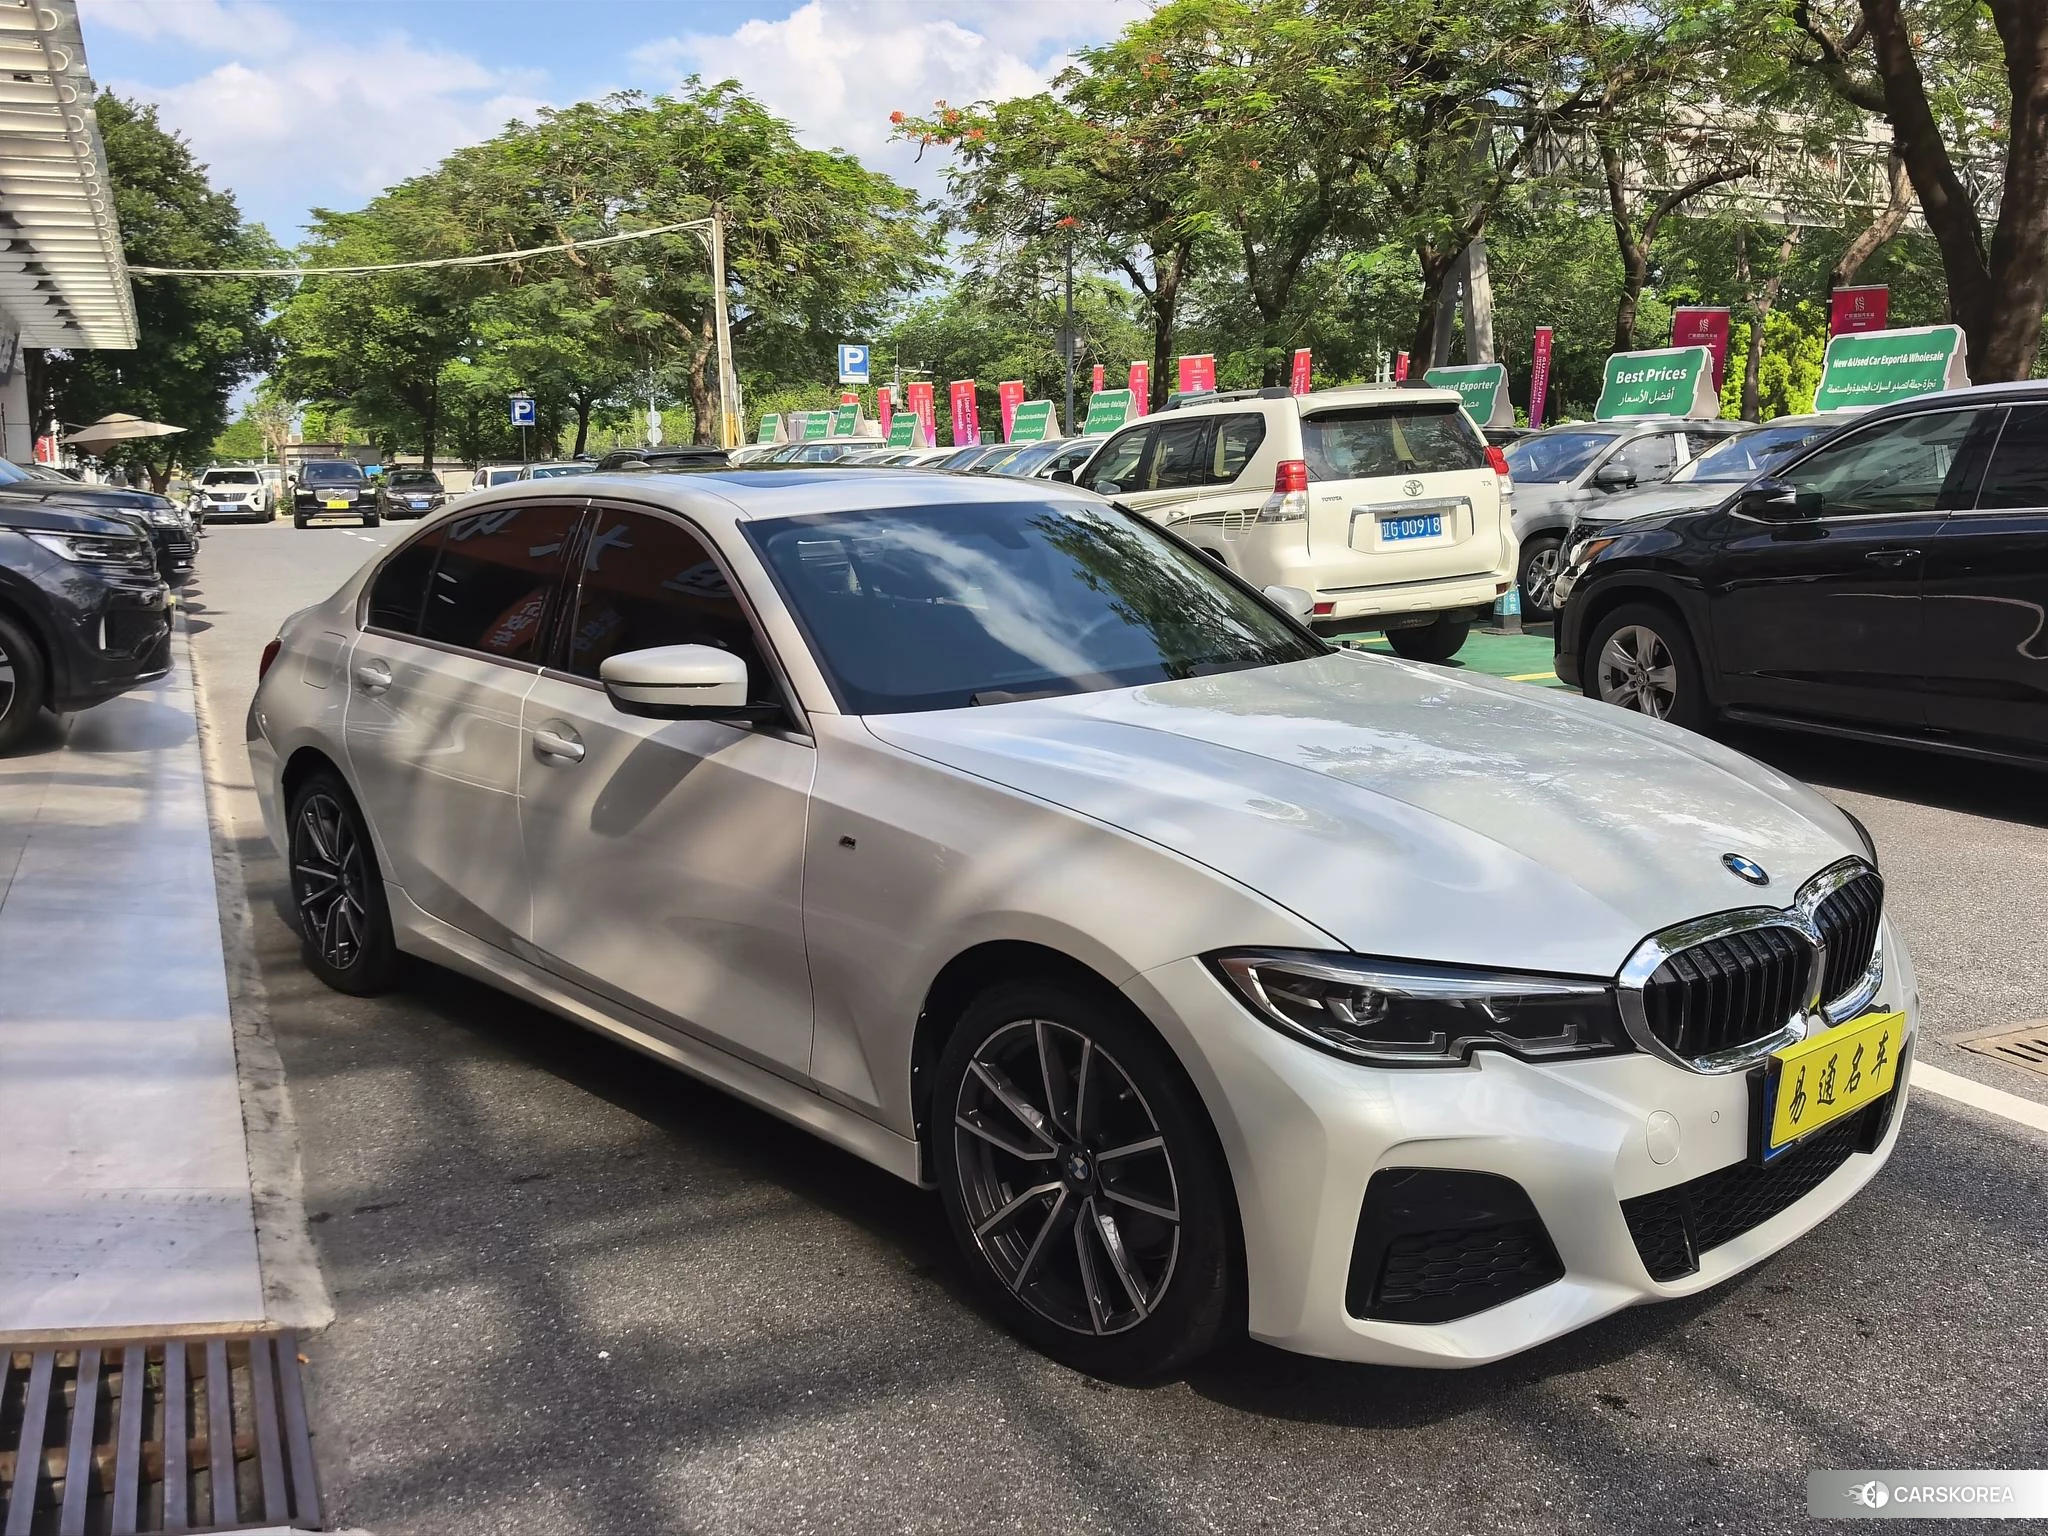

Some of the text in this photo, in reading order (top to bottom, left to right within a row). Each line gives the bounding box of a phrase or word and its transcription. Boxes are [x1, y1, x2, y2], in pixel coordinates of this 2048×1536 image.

[844, 347, 864, 371] P
[1833, 358, 1847, 368] New
[1869, 355, 1882, 366] Car
[1909, 350, 1944, 363] Wholesale
[1615, 366, 1687, 384] Best Prices
[1460, 381, 1495, 392] Exporter
[1618, 386, 1675, 406] أفضل الأسعار
[515, 401, 531, 420] P
